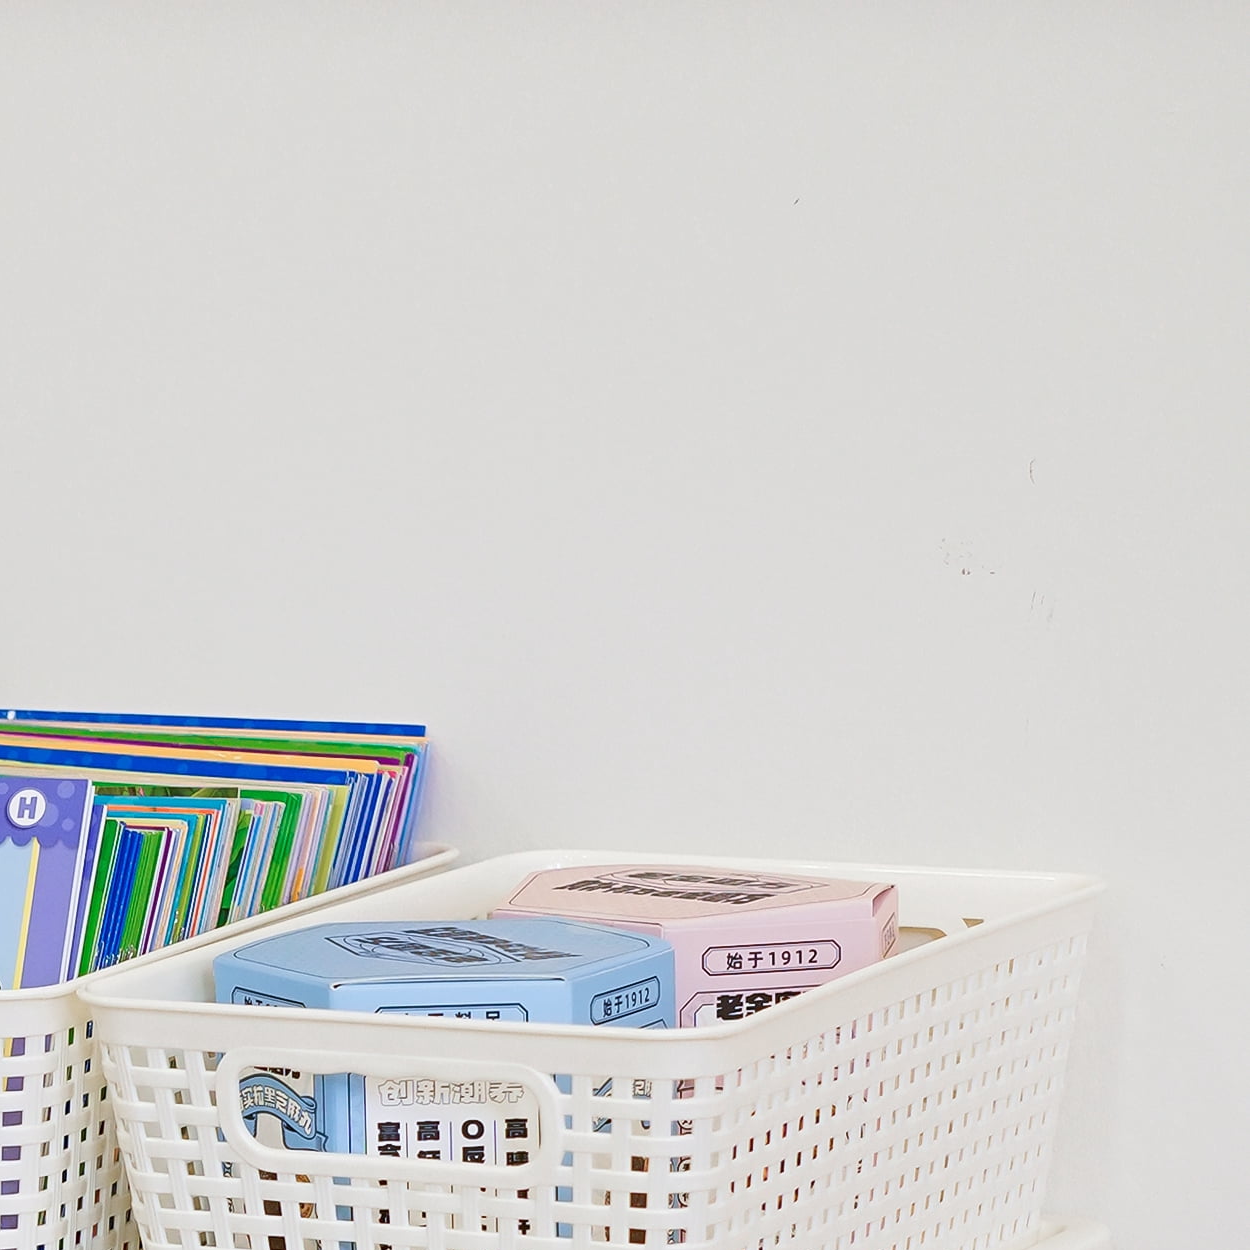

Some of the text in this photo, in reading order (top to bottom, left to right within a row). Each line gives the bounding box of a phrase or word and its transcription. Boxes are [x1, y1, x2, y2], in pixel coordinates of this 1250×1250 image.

[16, 796, 38, 819] H
[726, 949, 818, 971] 始于1912
[602, 986, 650, 1018] 始于1912
